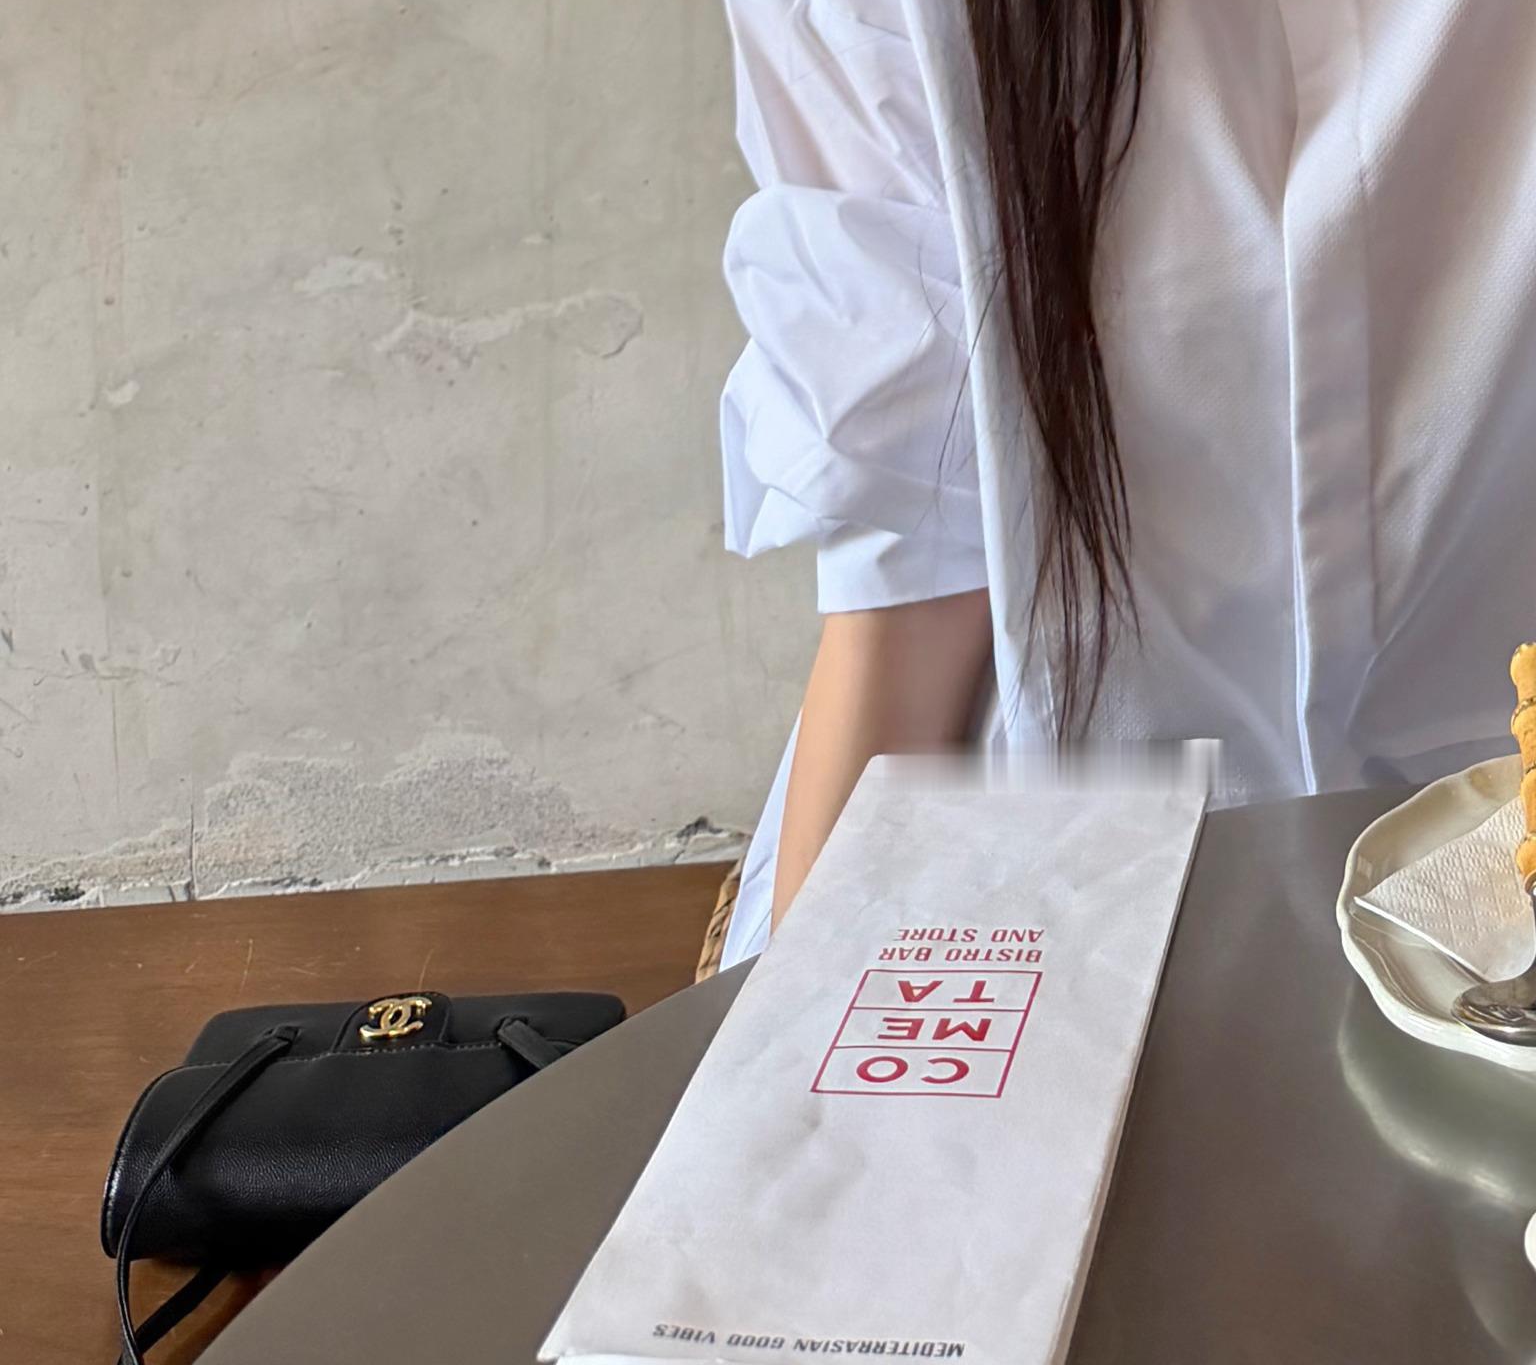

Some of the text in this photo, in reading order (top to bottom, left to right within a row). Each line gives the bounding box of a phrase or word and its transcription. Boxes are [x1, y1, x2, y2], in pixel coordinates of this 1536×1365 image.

[894, 927, 1044, 943] AND STORE
[878, 947, 1043, 963] BISTRO BAR
[897, 980, 995, 1003] TA
[877, 1017, 992, 1042] ME
[856, 1056, 970, 1084] CO
[652, 1323, 965, 1358] MEDITERRASIAN GOOD VIBES
